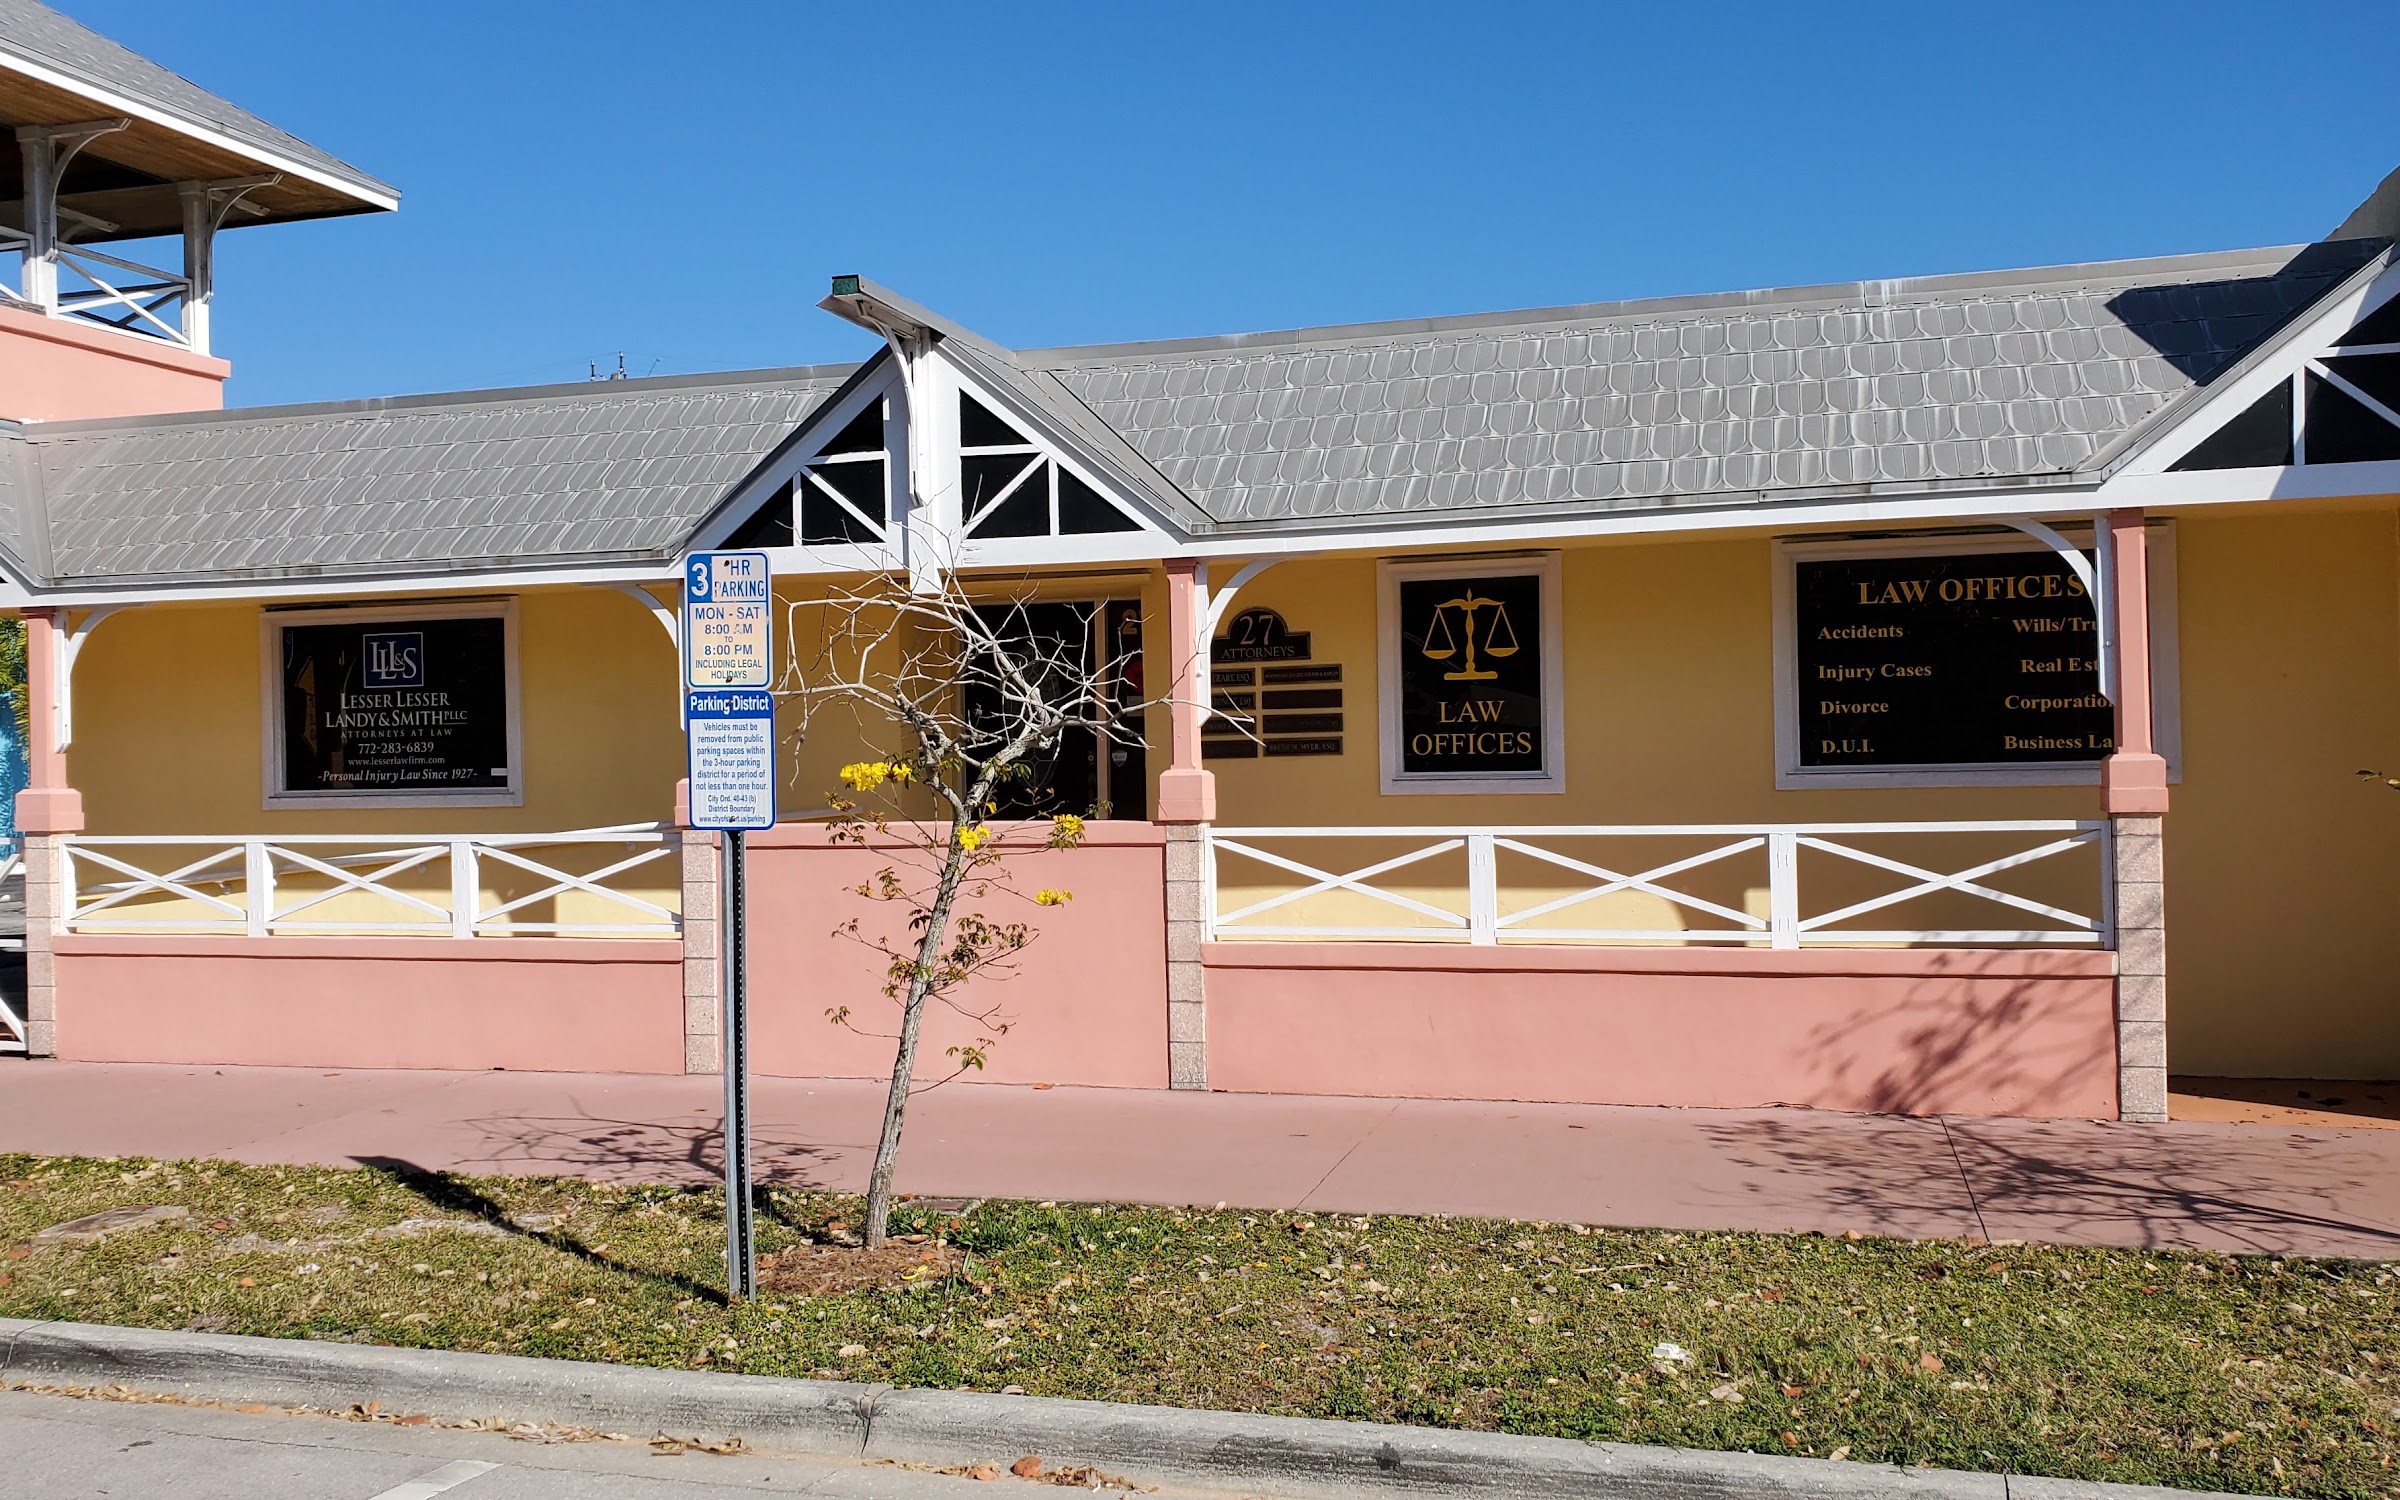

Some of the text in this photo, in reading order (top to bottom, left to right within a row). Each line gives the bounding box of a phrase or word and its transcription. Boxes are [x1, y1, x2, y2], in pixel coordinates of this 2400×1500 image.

[730, 559, 750, 576] HR
[691, 562, 709, 596] 3
[714, 580, 764, 597] PARKING
[1858, 574, 2084, 605] LAW OFFICES
[695, 607, 724, 620] MON
[736, 606, 760, 620] SAT
[704, 624, 752, 634] 8:00 AM
[1239, 614, 1274, 646] 27
[2012, 617, 2097, 632] Wills/Tru
[1817, 625, 1904, 640] Accidents
[704, 644, 752, 656] 8:00 PM
[1221, 646, 1295, 660] ATTORNEYS
[696, 659, 762, 668] INCLUDING LEGAL
[2020, 658, 2098, 673] Real Est
[711, 670, 748, 680] HOLIDAYS
[1818, 663, 1932, 681] Injury Cases
[341, 690, 450, 710] LESSER LESSER
[690, 694, 770, 714] Parking District
[444, 710, 468, 720] PLLC
[1438, 700, 1505, 723] LAW
[1820, 702, 1889, 716] Divorce
[340, 728, 452, 739] ATTORNEYS AT LAW
[704, 722, 731, 731] Vehicles
[750, 722, 758, 731] be
[698, 734, 764, 744] removed from public
[1412, 732, 1532, 756] OFFICES
[2004, 734, 2113, 750] Business La
[358, 742, 434, 754] 772-283-6839
[696, 746, 766, 756] parking spaces within
[1821, 739, 1874, 754] D.U.I.
[348, 756, 446, 766] www.lesserlawfirm.com
[714, 758, 736, 766] 3-hour
[736, 758, 760, 768] parking
[364, 770, 398, 784] Injury
[400, 770, 420, 780] Law
[422, 768, 448, 780] Since
[697, 770, 720, 779] district
[721, 770, 730, 778] for
[737, 770, 758, 780] period
[759, 770, 766, 778] of
[708, 782, 721, 790] less
[722, 782, 736, 790] than
[752, 782, 768, 790] hour.
[708, 794, 718, 804] City
[720, 794, 732, 802] Ord.
[730, 805, 756, 814] Boundary
